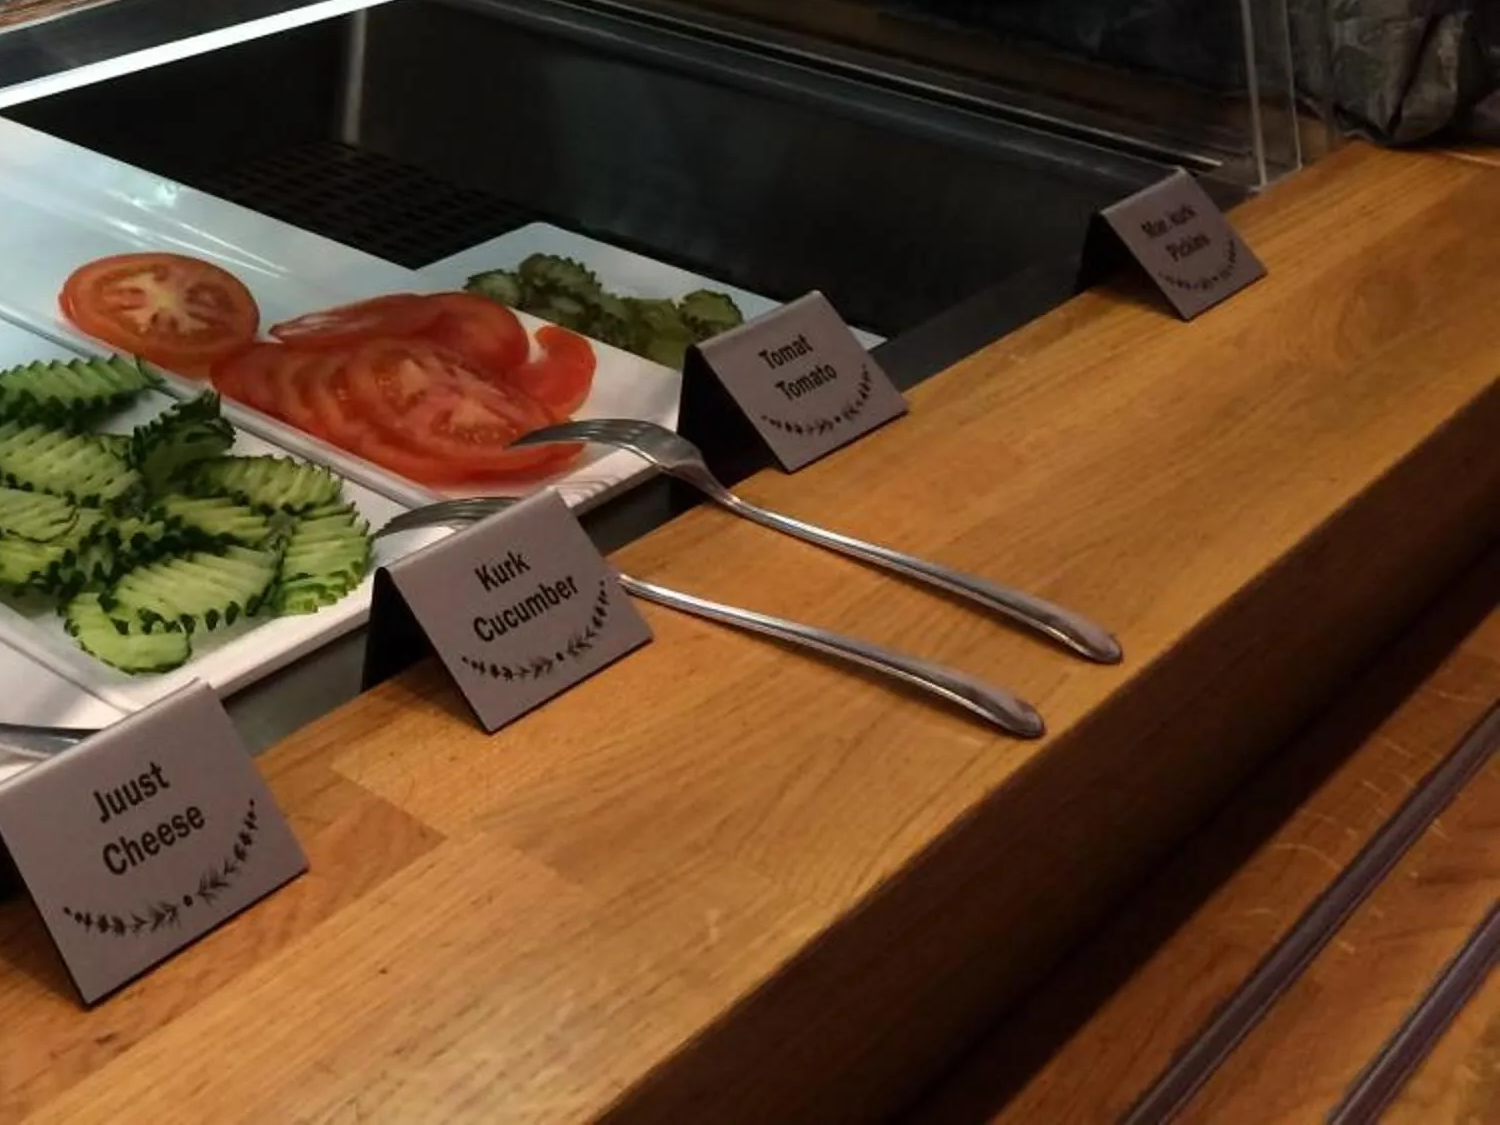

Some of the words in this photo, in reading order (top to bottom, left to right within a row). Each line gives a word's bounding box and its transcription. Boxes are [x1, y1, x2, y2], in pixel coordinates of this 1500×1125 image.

[757, 333, 813, 370] Tomat
[774, 362, 838, 401] Tomato
[473, 549, 532, 593] Kurk
[472, 574, 580, 642] Cucumber
[92, 761, 170, 824] Juust
[102, 805, 206, 876] Cheese
